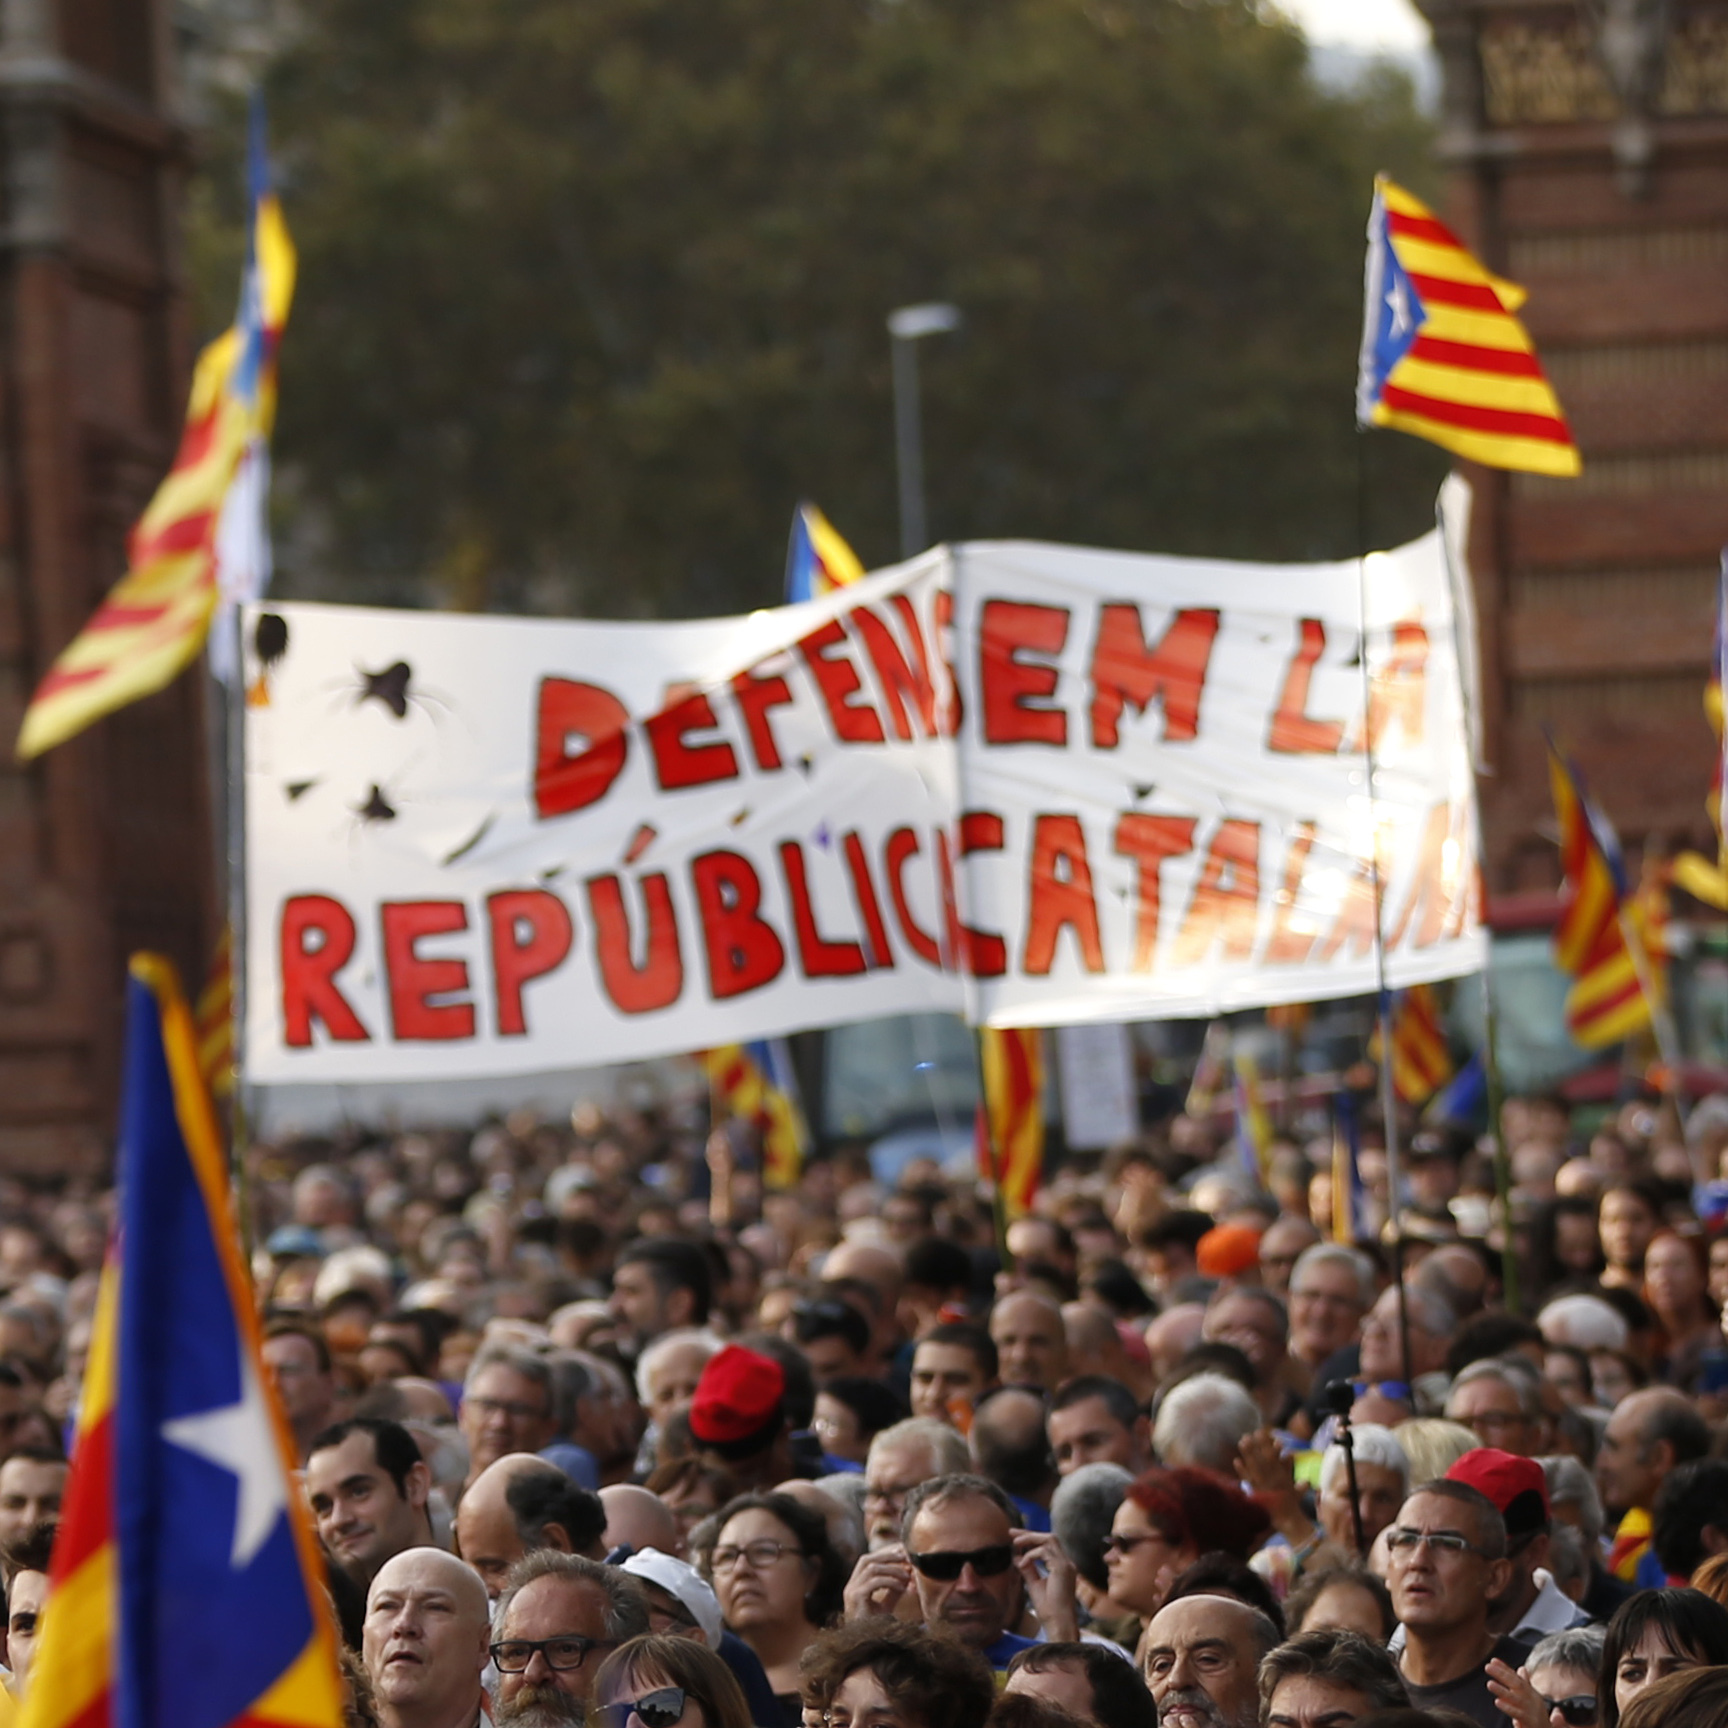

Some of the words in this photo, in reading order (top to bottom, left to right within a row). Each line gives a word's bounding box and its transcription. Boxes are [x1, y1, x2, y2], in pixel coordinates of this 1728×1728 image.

[1268, 616, 1429, 755] LA
[280, 824, 960, 1047] REPÚBLIC
[956, 800, 1487, 976] CATALAN
